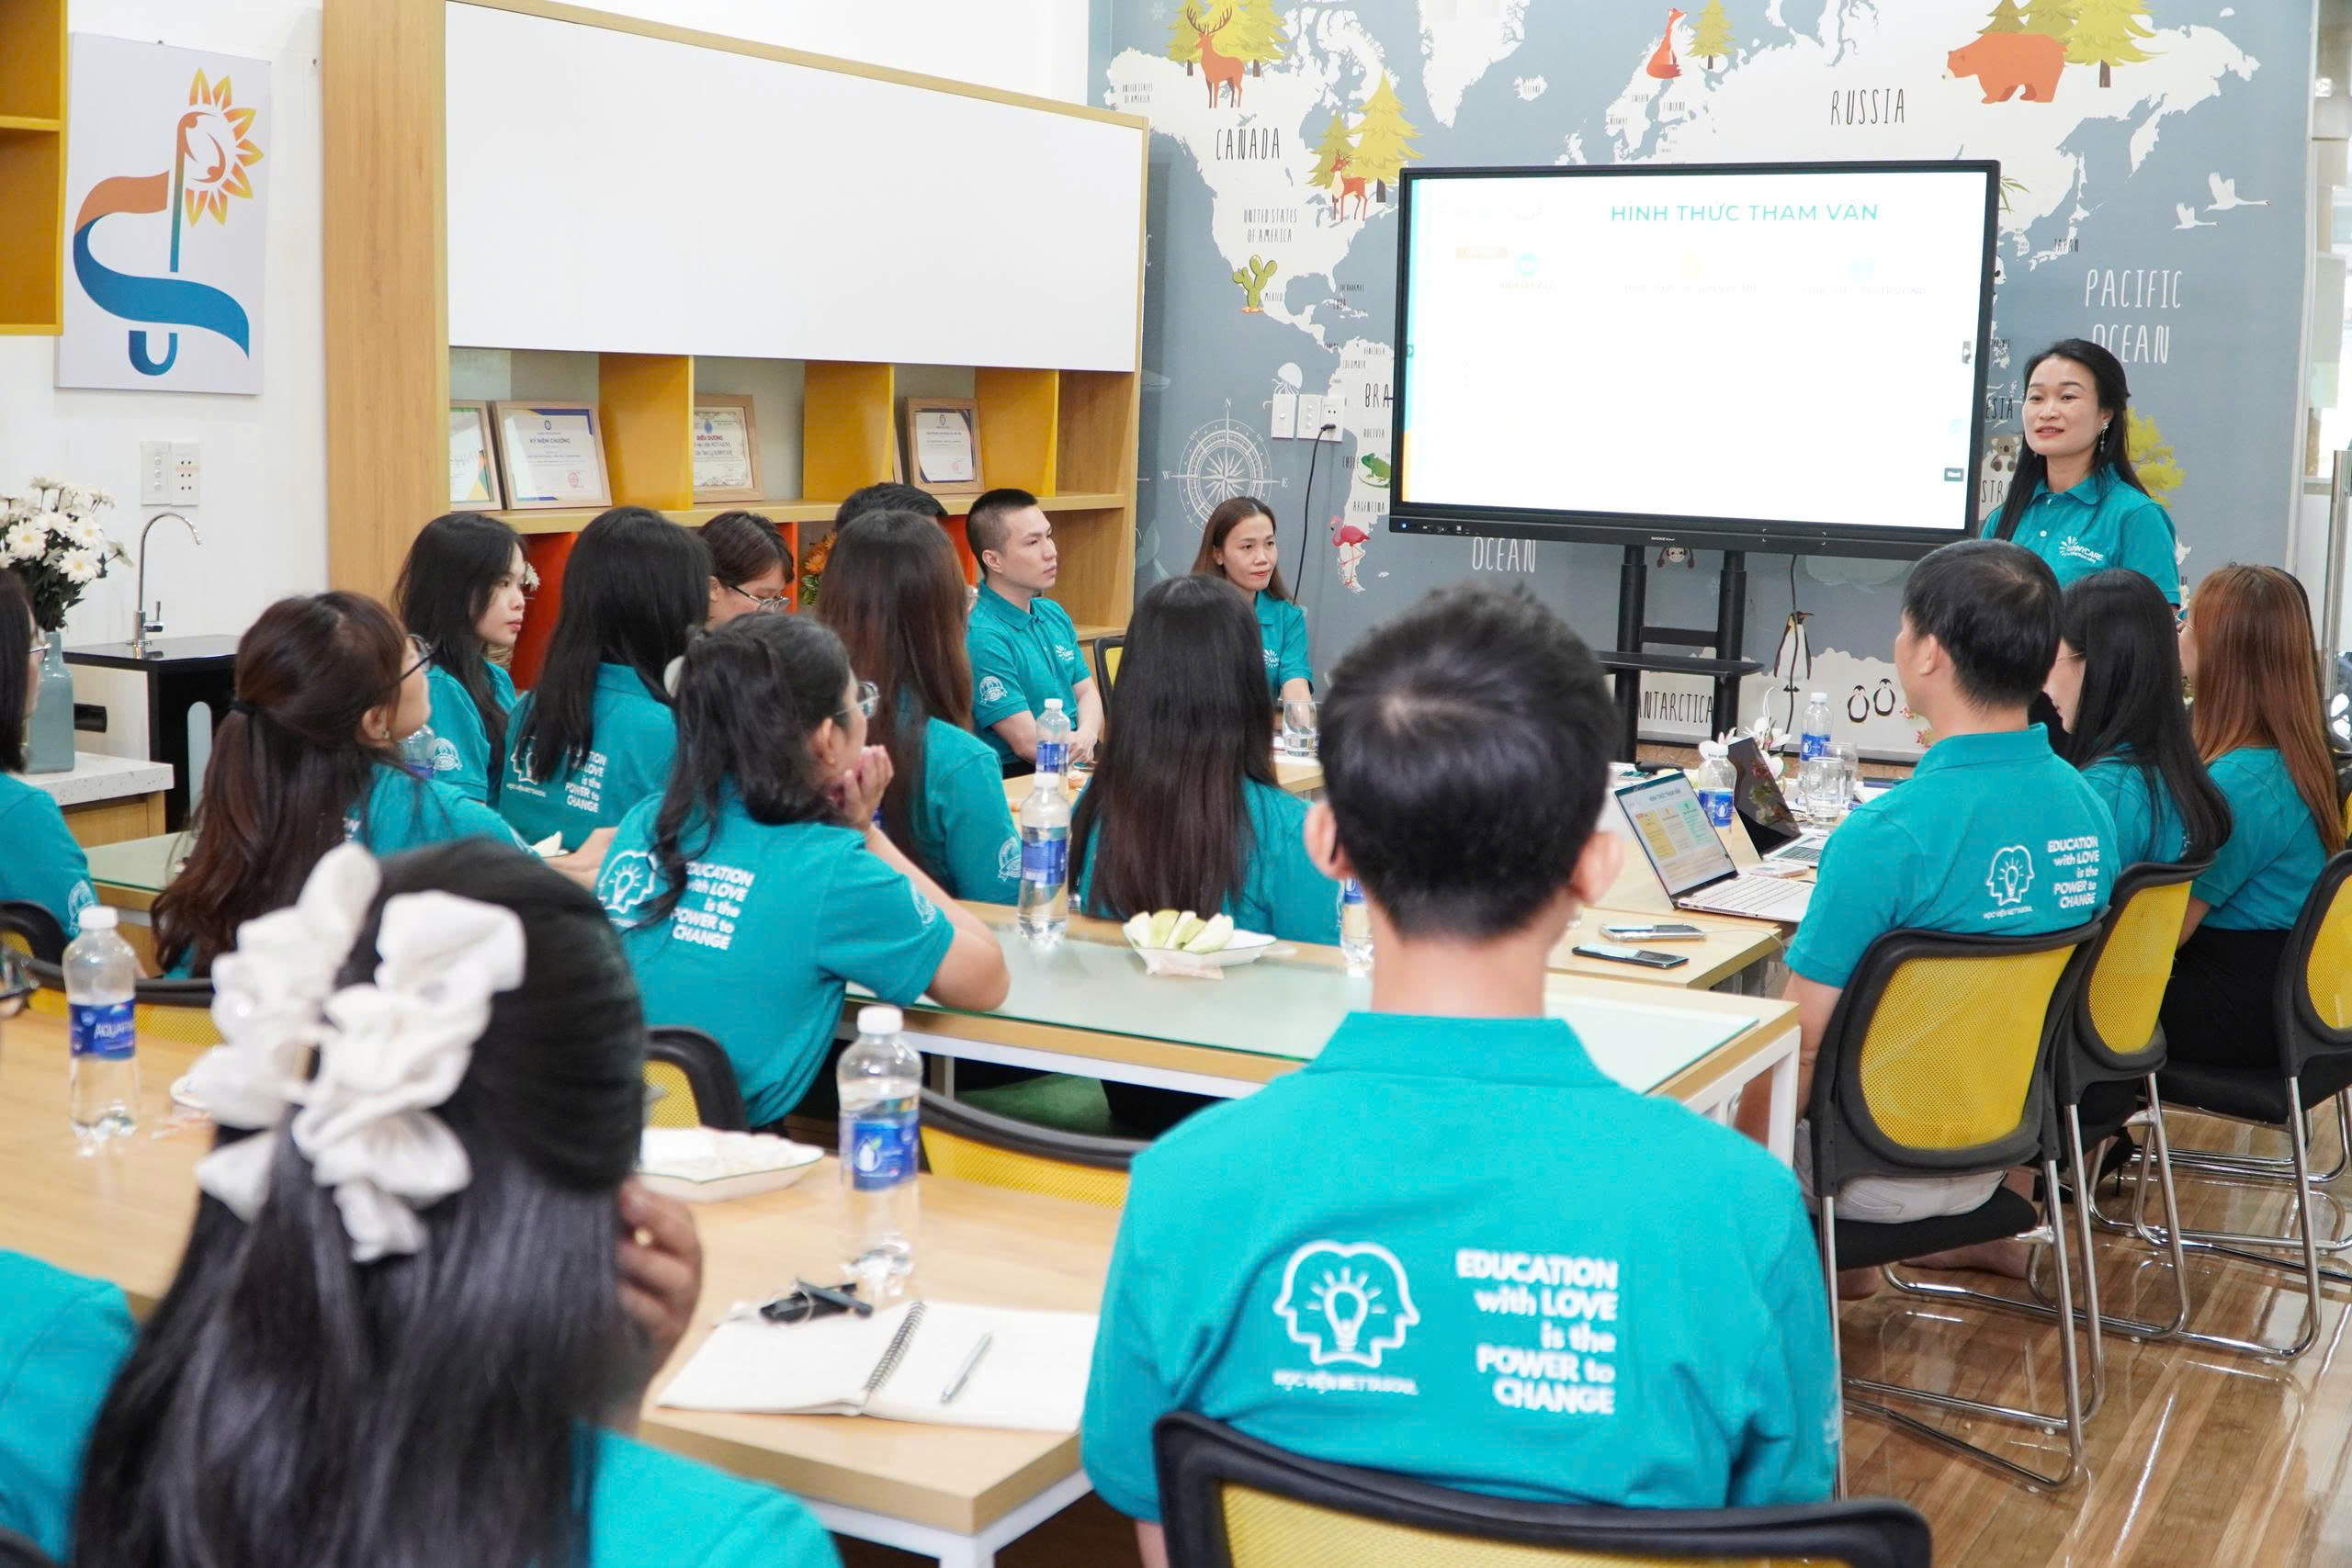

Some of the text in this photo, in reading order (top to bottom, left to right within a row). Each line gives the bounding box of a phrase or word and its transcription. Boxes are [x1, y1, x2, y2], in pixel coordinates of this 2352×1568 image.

[1830, 88, 1905, 126] RUSSIA
[1216, 127, 1280, 161] CANADA
[1243, 208, 1298, 223] UNITED STATES
[1748, 204, 1816, 221] THAM
[1247, 228, 1292, 243] OF AMERICA
[2053, 238, 2079, 253] JAPAN
[2084, 268, 2184, 310] PACIFIC
[2092, 323, 2171, 365] OCEAN
[1226, 398, 1232, 408] N
[1364, 382, 1390, 408] BRA
[1282, 477, 1288, 488] E
[1353, 500, 1385, 513] ARGENTINA
[1472, 536, 1537, 573] OCEAN
[584, 762, 605, 777] LOVE
[581, 775, 589, 785] is
[565, 782, 600, 801] POWER to
[566, 795, 600, 813] CHANGE
[2047, 835, 2099, 853] EDUCATION
[2053, 850, 2099, 866] with LOVE
[2076, 865, 2099, 878] is the
[709, 881, 750, 902] LOVE
[2053, 880, 2097, 896] POWER to
[704, 897, 741, 919] is the
[2059, 892, 2096, 908] CHANGE
[671, 906, 735, 933] POWER to
[672, 923, 732, 951] CHANGE
[1455, 1248, 1620, 1290] EDUCATION
[1474, 1286, 1620, 1321] with LOVE
[1540, 1321, 1617, 1352] is the
[1476, 1343, 1616, 1384] POWER to
[1492, 1378, 1616, 1415] CHANGE
